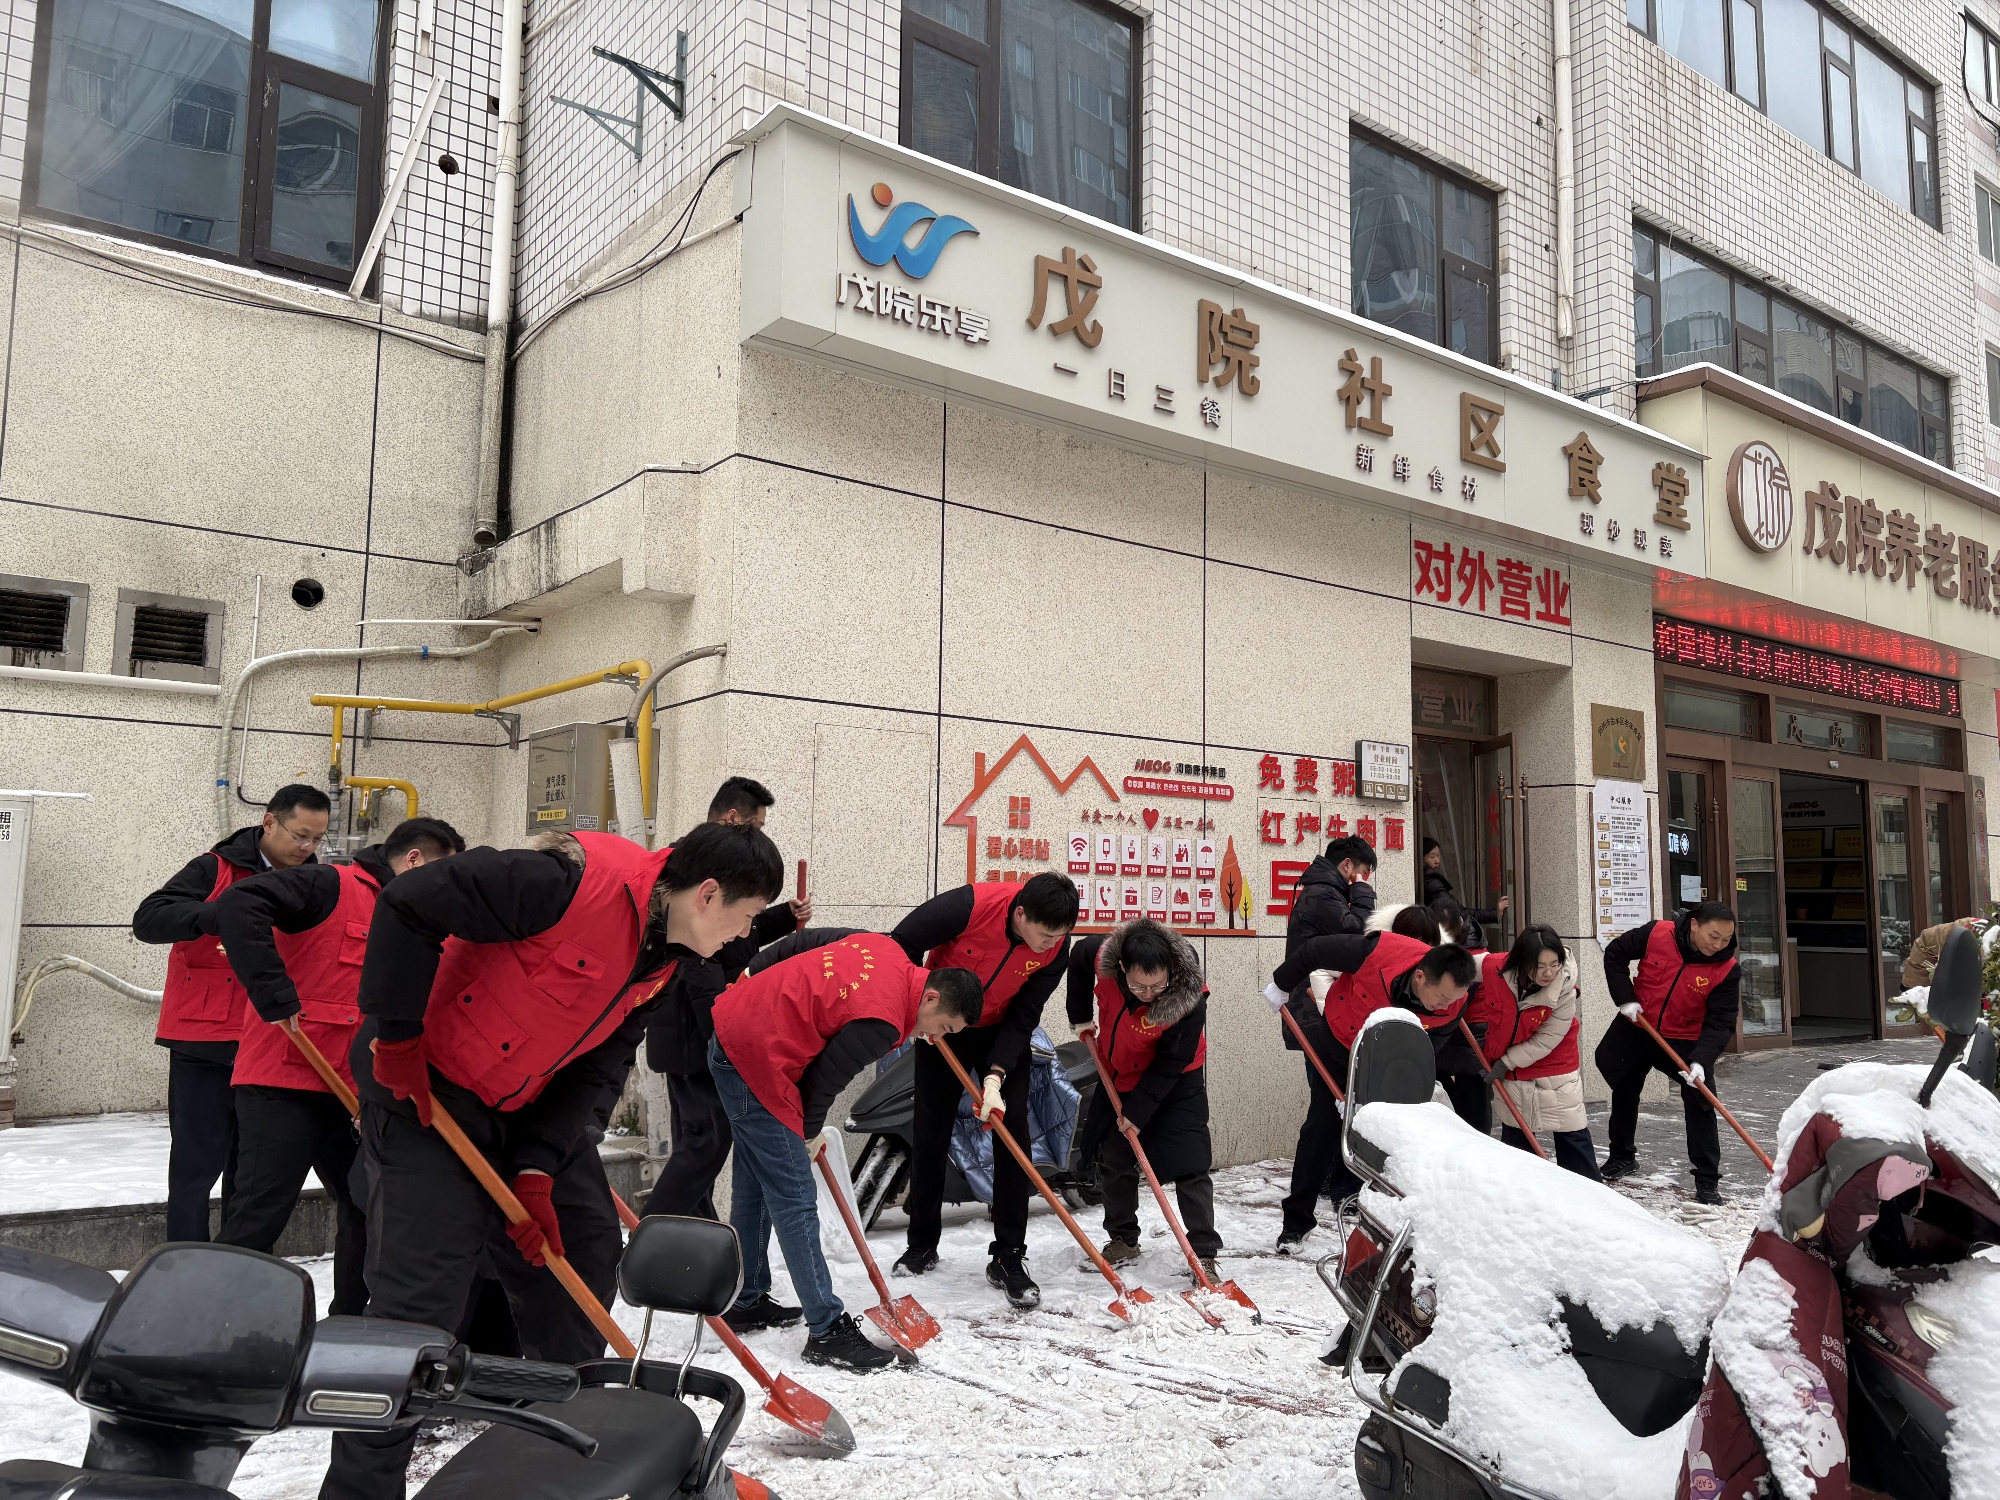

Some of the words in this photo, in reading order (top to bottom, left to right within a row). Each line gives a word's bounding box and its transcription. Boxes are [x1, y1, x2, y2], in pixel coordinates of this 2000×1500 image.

[837, 272, 991, 344] 戊院乐享
[1027, 246, 1691, 531] 戊院社区食堂
[1054, 362, 1222, 428] 一日三餐
[1356, 443, 1479, 502] 新鲜食材
[1580, 512, 1674, 559] 现炒现卖
[1803, 480, 2000, 615] 戊院养老服
[1413, 540, 1571, 627] 对外营业
[1418, 681, 1478, 728] 营业
[1258, 754, 1356, 796] 免费粥
[1373, 754, 1398, 765] 营业时间
[987, 835, 1050, 861] 爱心驿站
[1260, 809, 1406, 851] 红烧牛肉面
[1600, 833, 1607, 841] 4F
[1602, 889, 1609, 897] 2F
[1602, 908, 1610, 916] 1F
